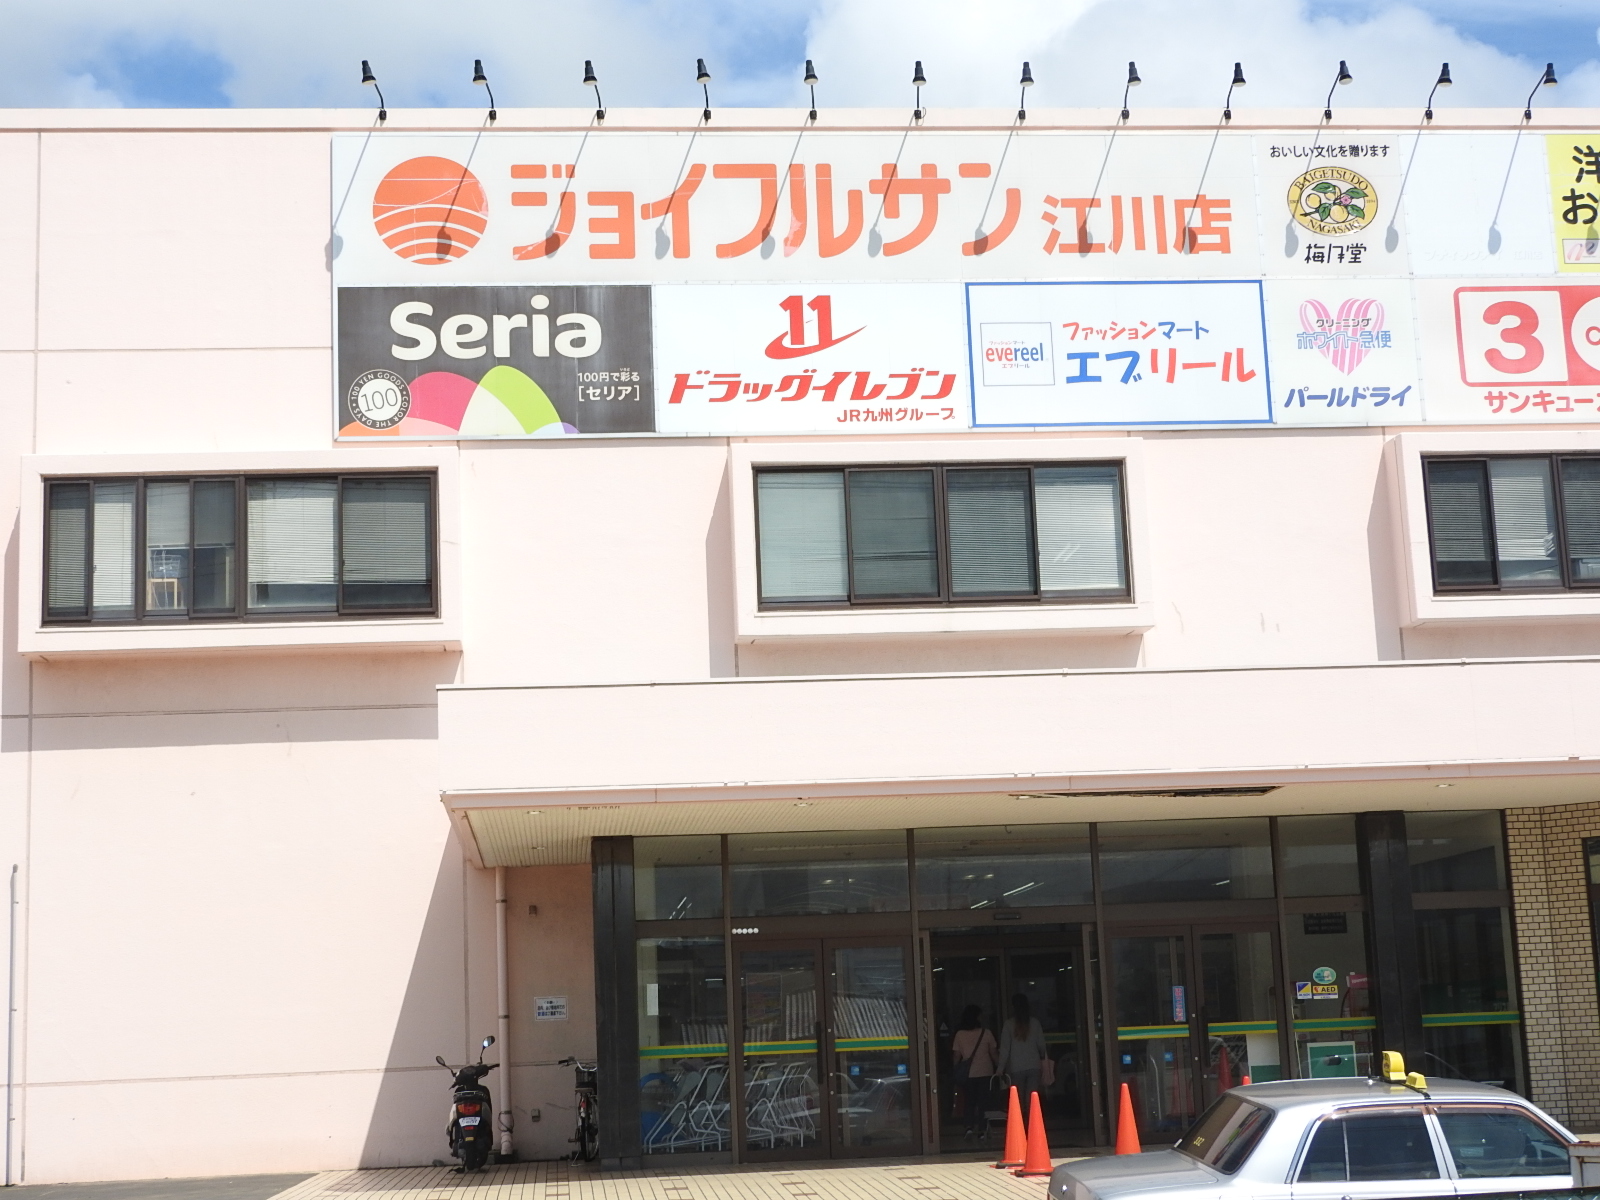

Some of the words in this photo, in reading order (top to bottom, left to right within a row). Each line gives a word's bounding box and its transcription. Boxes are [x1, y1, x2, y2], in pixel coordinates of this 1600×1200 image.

[1269, 144, 1390, 158] おいしい文化を贈ります
[1294, 168, 1369, 191] BAIGETSUDO
[510, 163, 1021, 261] ジョイフルサン
[1041, 194, 1233, 255] 江川店
[1562, 188, 1599, 225] お
[1307, 219, 1362, 234] NAGASAKI
[1304, 243, 1367, 264] 梅月堂
[389, 294, 602, 360] Seria
[1062, 320, 1209, 341] ファッションマート
[1316, 318, 1371, 328] クリーニング
[1296, 330, 1392, 349] ホワイト急便
[1482, 300, 1545, 374] 3
[985, 342, 1044, 362] evereel
[577, 371, 640, 382] 100円で彩る
[1065, 347, 1257, 385] エブリール
[358, 373, 375, 385] YEN
[377, 372, 405, 390] GOODS
[668, 368, 957, 404] ドラッグイレブン
[361, 388, 398, 412] 100
[578, 384, 640, 402] [セリア]
[1283, 385, 1412, 408] パールドライ
[1483, 390, 1600, 414] サンキュー
[353, 407, 373, 426] DAYS
[393, 396, 409, 422] COLOR
[375, 420, 392, 428] THE
